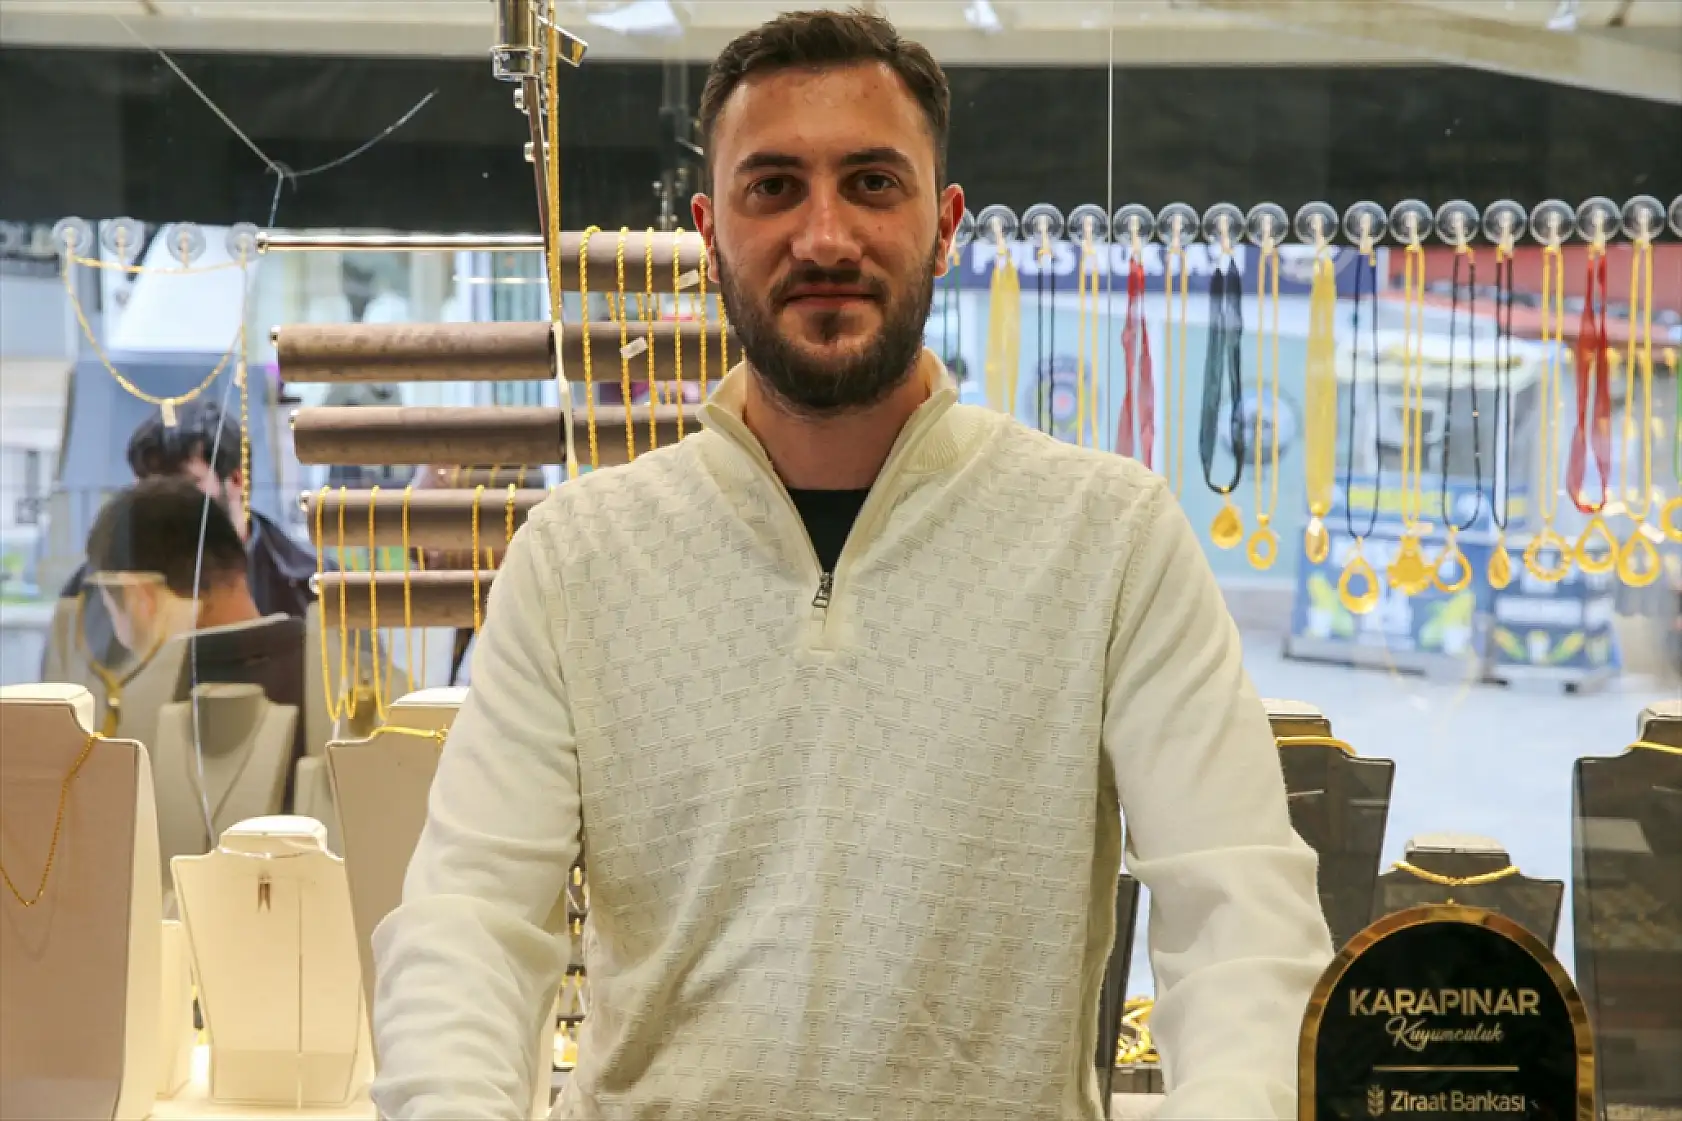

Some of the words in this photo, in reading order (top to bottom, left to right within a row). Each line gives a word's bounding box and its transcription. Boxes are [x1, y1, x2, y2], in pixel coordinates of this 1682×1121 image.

[1349, 987, 1541, 1016] KARAPINAR
[1385, 1016, 1504, 1052] Kuyumculuk
[1390, 1090, 1447, 1112] Ziraat
[1451, 1089, 1526, 1112] Bankası
